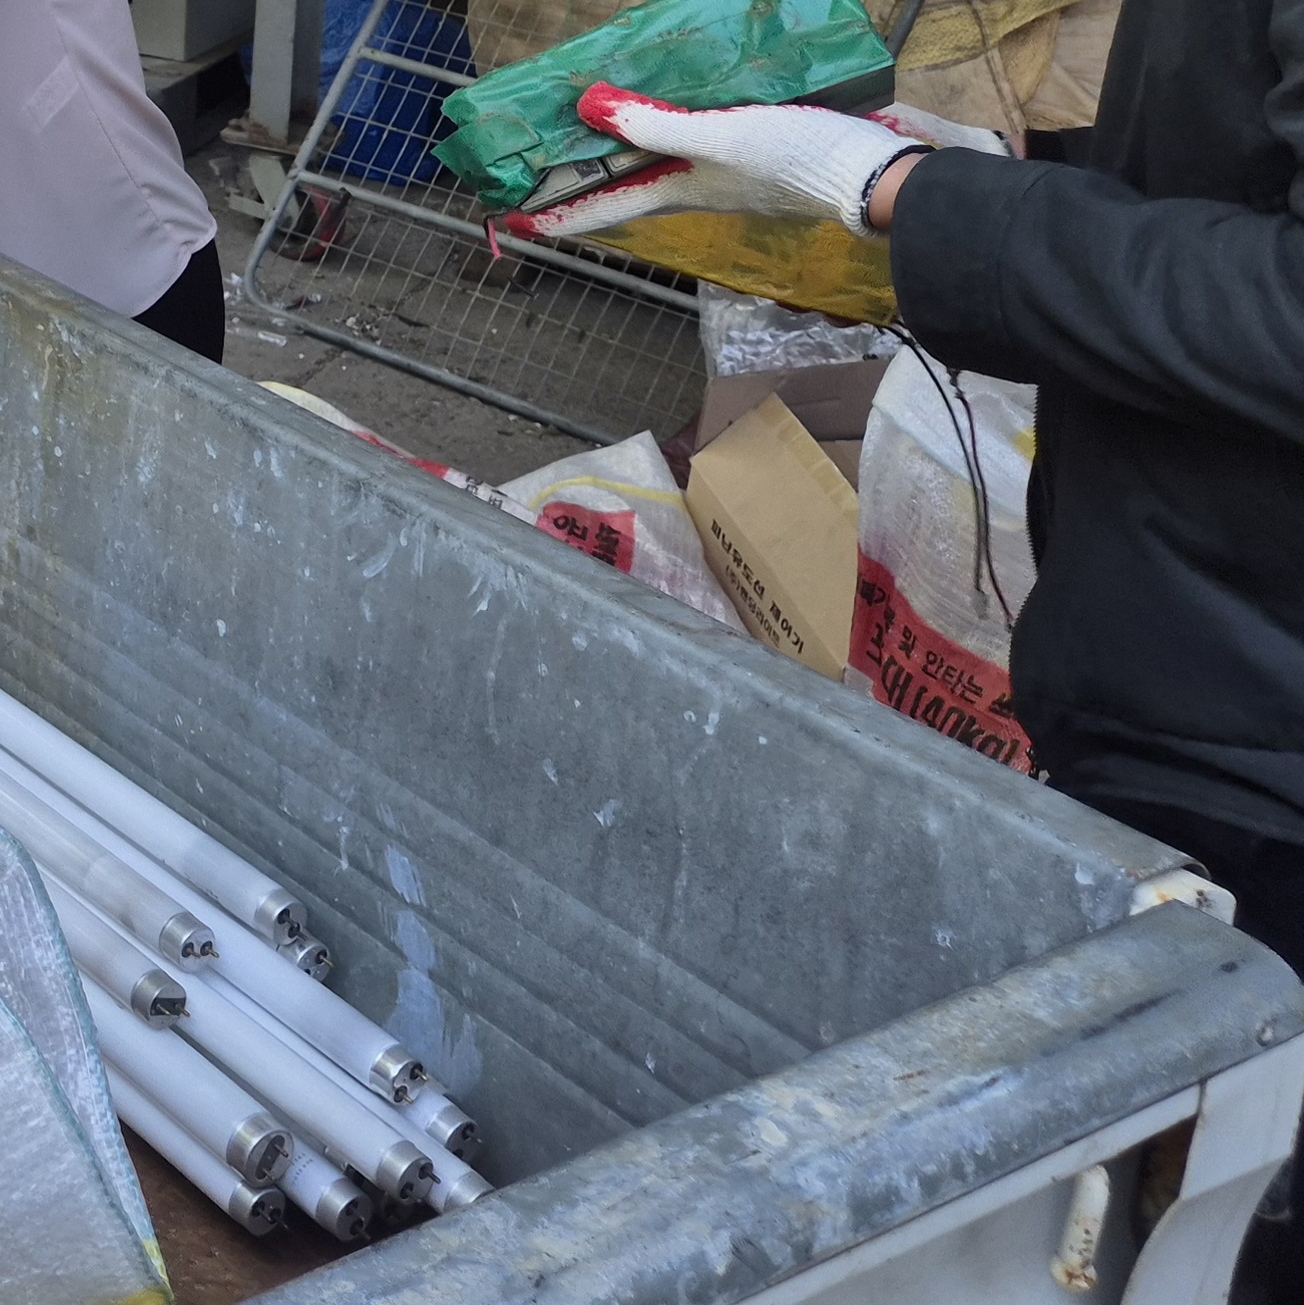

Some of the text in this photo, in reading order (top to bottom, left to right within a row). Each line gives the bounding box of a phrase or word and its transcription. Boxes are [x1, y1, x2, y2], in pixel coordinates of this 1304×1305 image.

[710, 517, 806, 656] 피난유도선 제어기
[921, 650, 984, 705] 안타는
